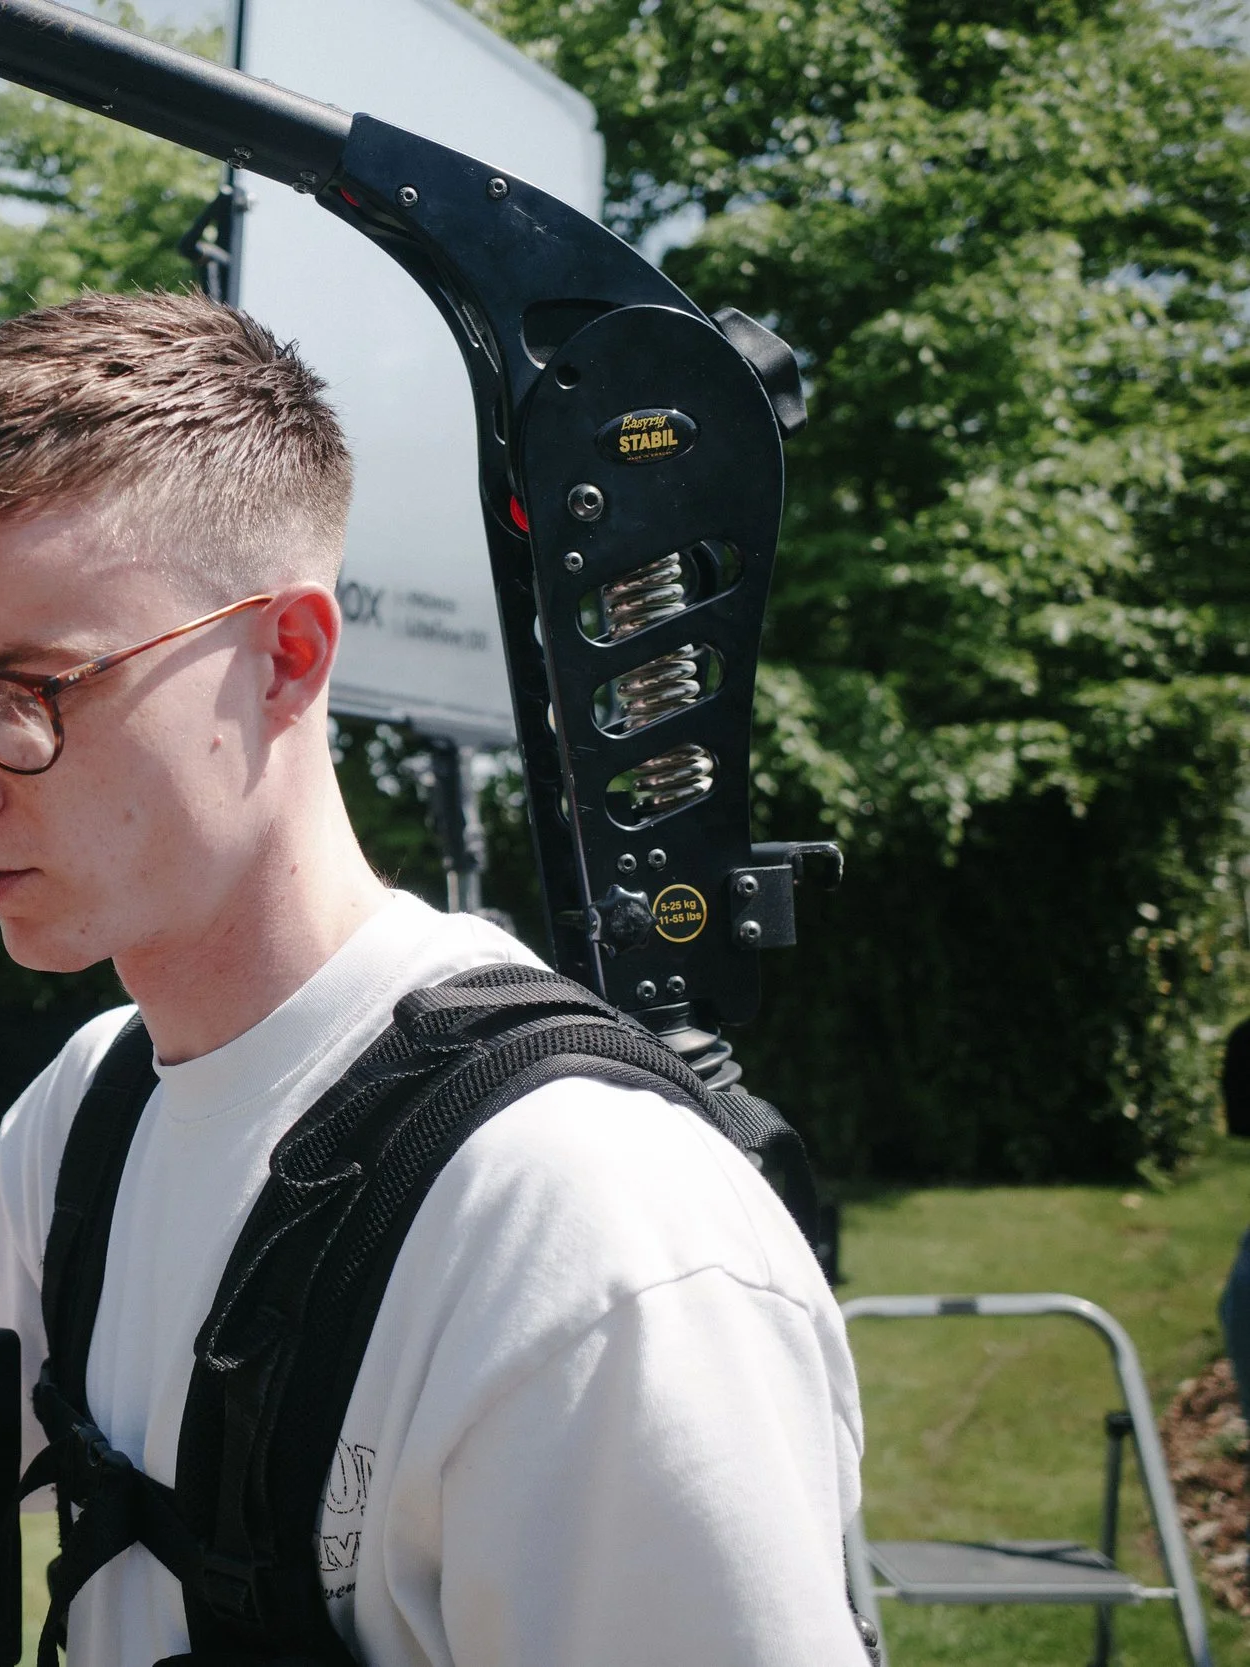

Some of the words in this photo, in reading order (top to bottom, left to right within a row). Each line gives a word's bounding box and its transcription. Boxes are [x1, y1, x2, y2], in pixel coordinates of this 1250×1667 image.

[621, 413, 668, 431] Easyrig
[619, 428, 678, 453] STABIL
[336, 578, 385, 629] OX
[660, 901, 682, 912] 5-25
[683, 899, 697, 910] kg
[658, 913, 684, 925] 11-55
[686, 911, 702, 921] lbs
